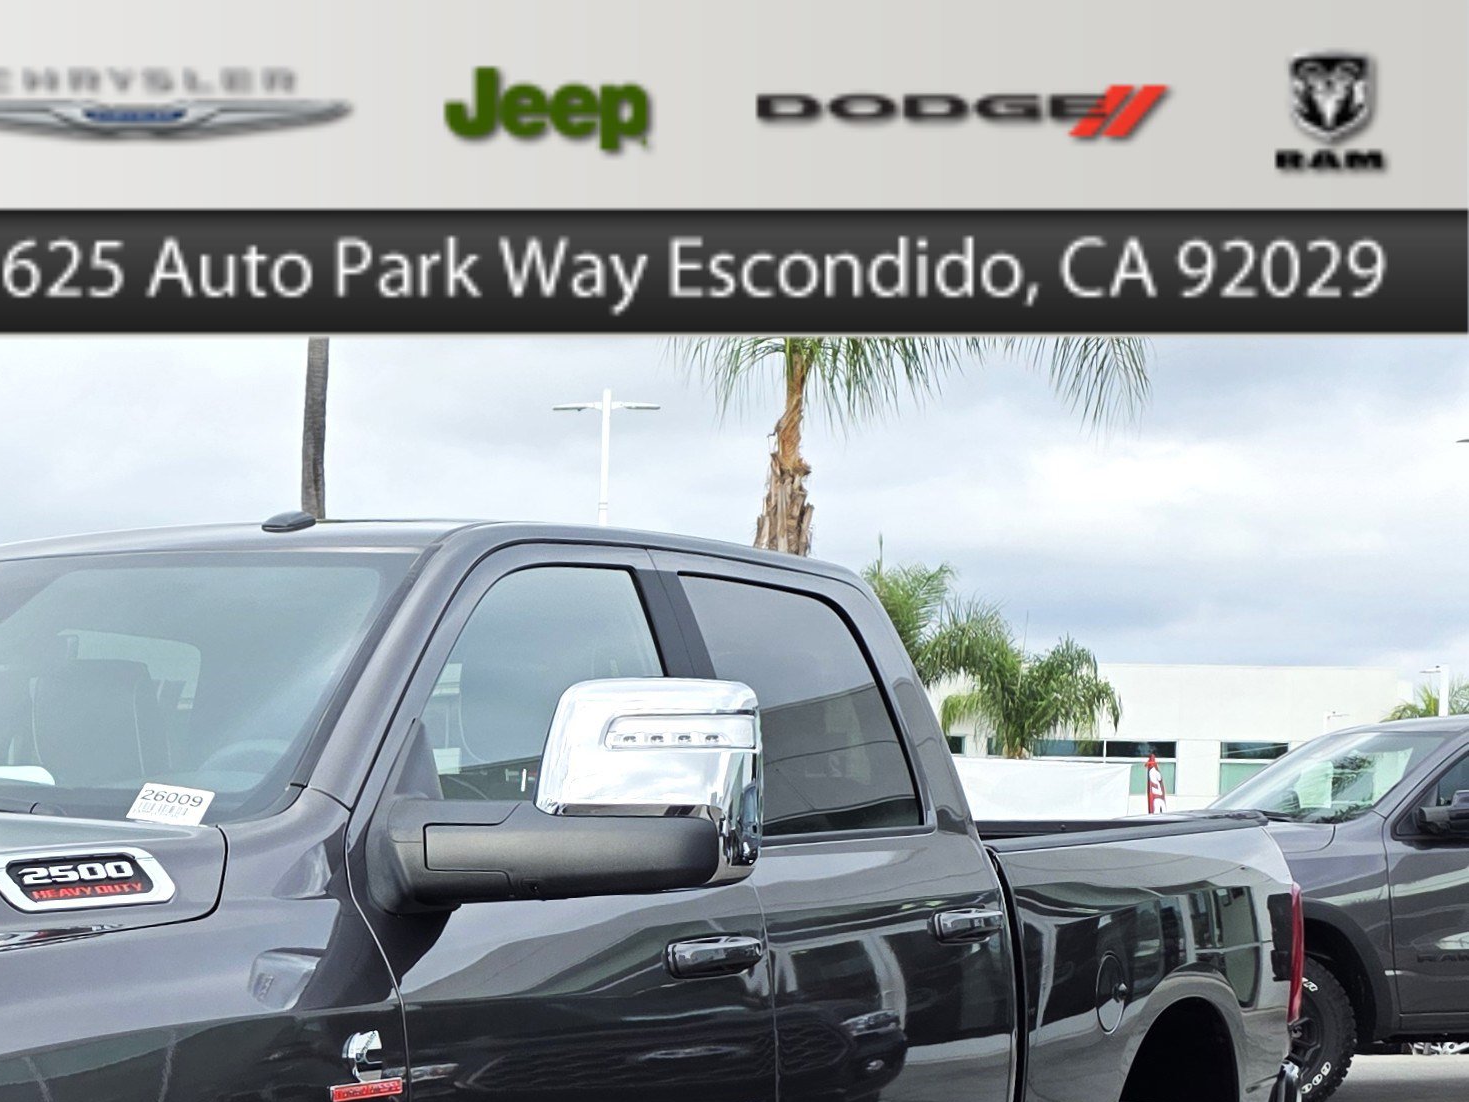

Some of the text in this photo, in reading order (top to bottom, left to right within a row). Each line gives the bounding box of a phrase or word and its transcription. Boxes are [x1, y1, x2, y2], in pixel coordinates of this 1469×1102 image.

[140, 789, 204, 808] 26009
[18, 860, 135, 886] 2500
[31, 881, 143, 900] HEAVY DUTY
